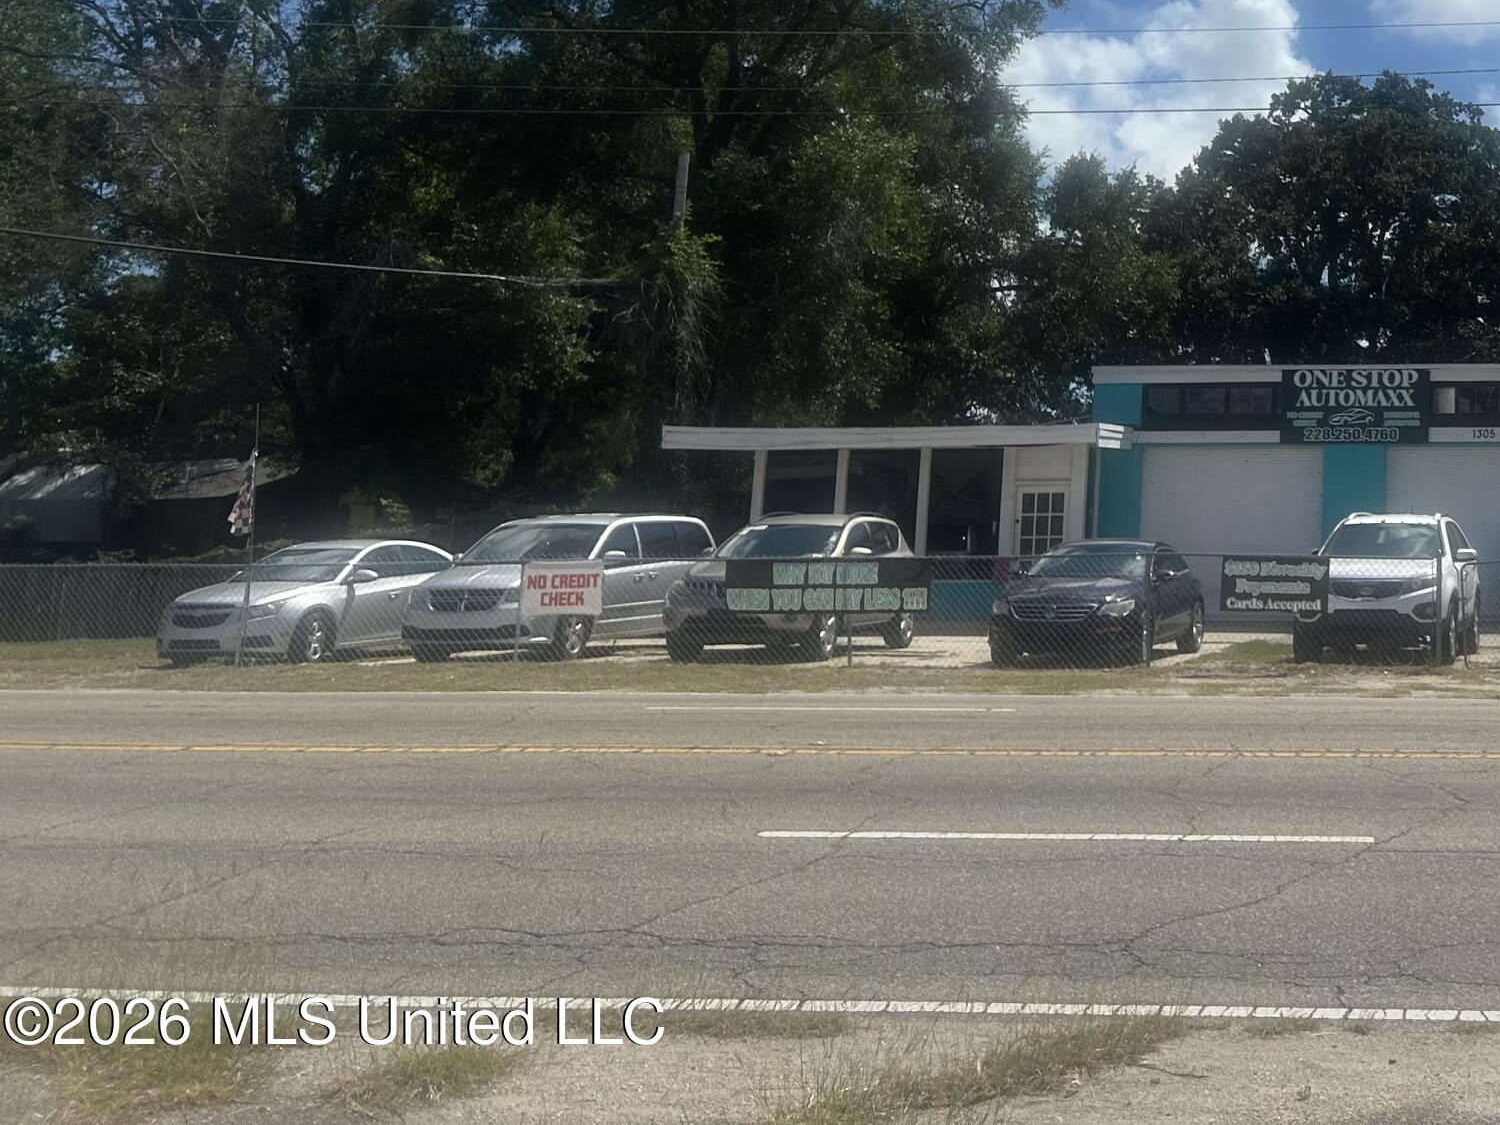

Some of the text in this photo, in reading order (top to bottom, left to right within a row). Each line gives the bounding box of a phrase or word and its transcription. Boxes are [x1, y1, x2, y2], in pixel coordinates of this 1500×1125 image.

[1293, 369, 1419, 388] ONE STOP
[1295, 389, 1416, 407] AUTOMAXX
[1303, 427, 1400, 442] 228.250.4760
[1472, 428, 1496, 439] 1305
[527, 573, 600, 590] NO CREDIT
[772, 562, 879, 585] WHY PAY MORE
[540, 591, 585, 607] CHECK
[726, 587, 770, 611] WHEN
[770, 587, 803, 611] YOU
[803, 587, 835, 611] CAN
[835, 587, 864, 611] PAY
[864, 587, 901, 611] LESS
[1226, 597, 1322, 613] Cards Accepted
